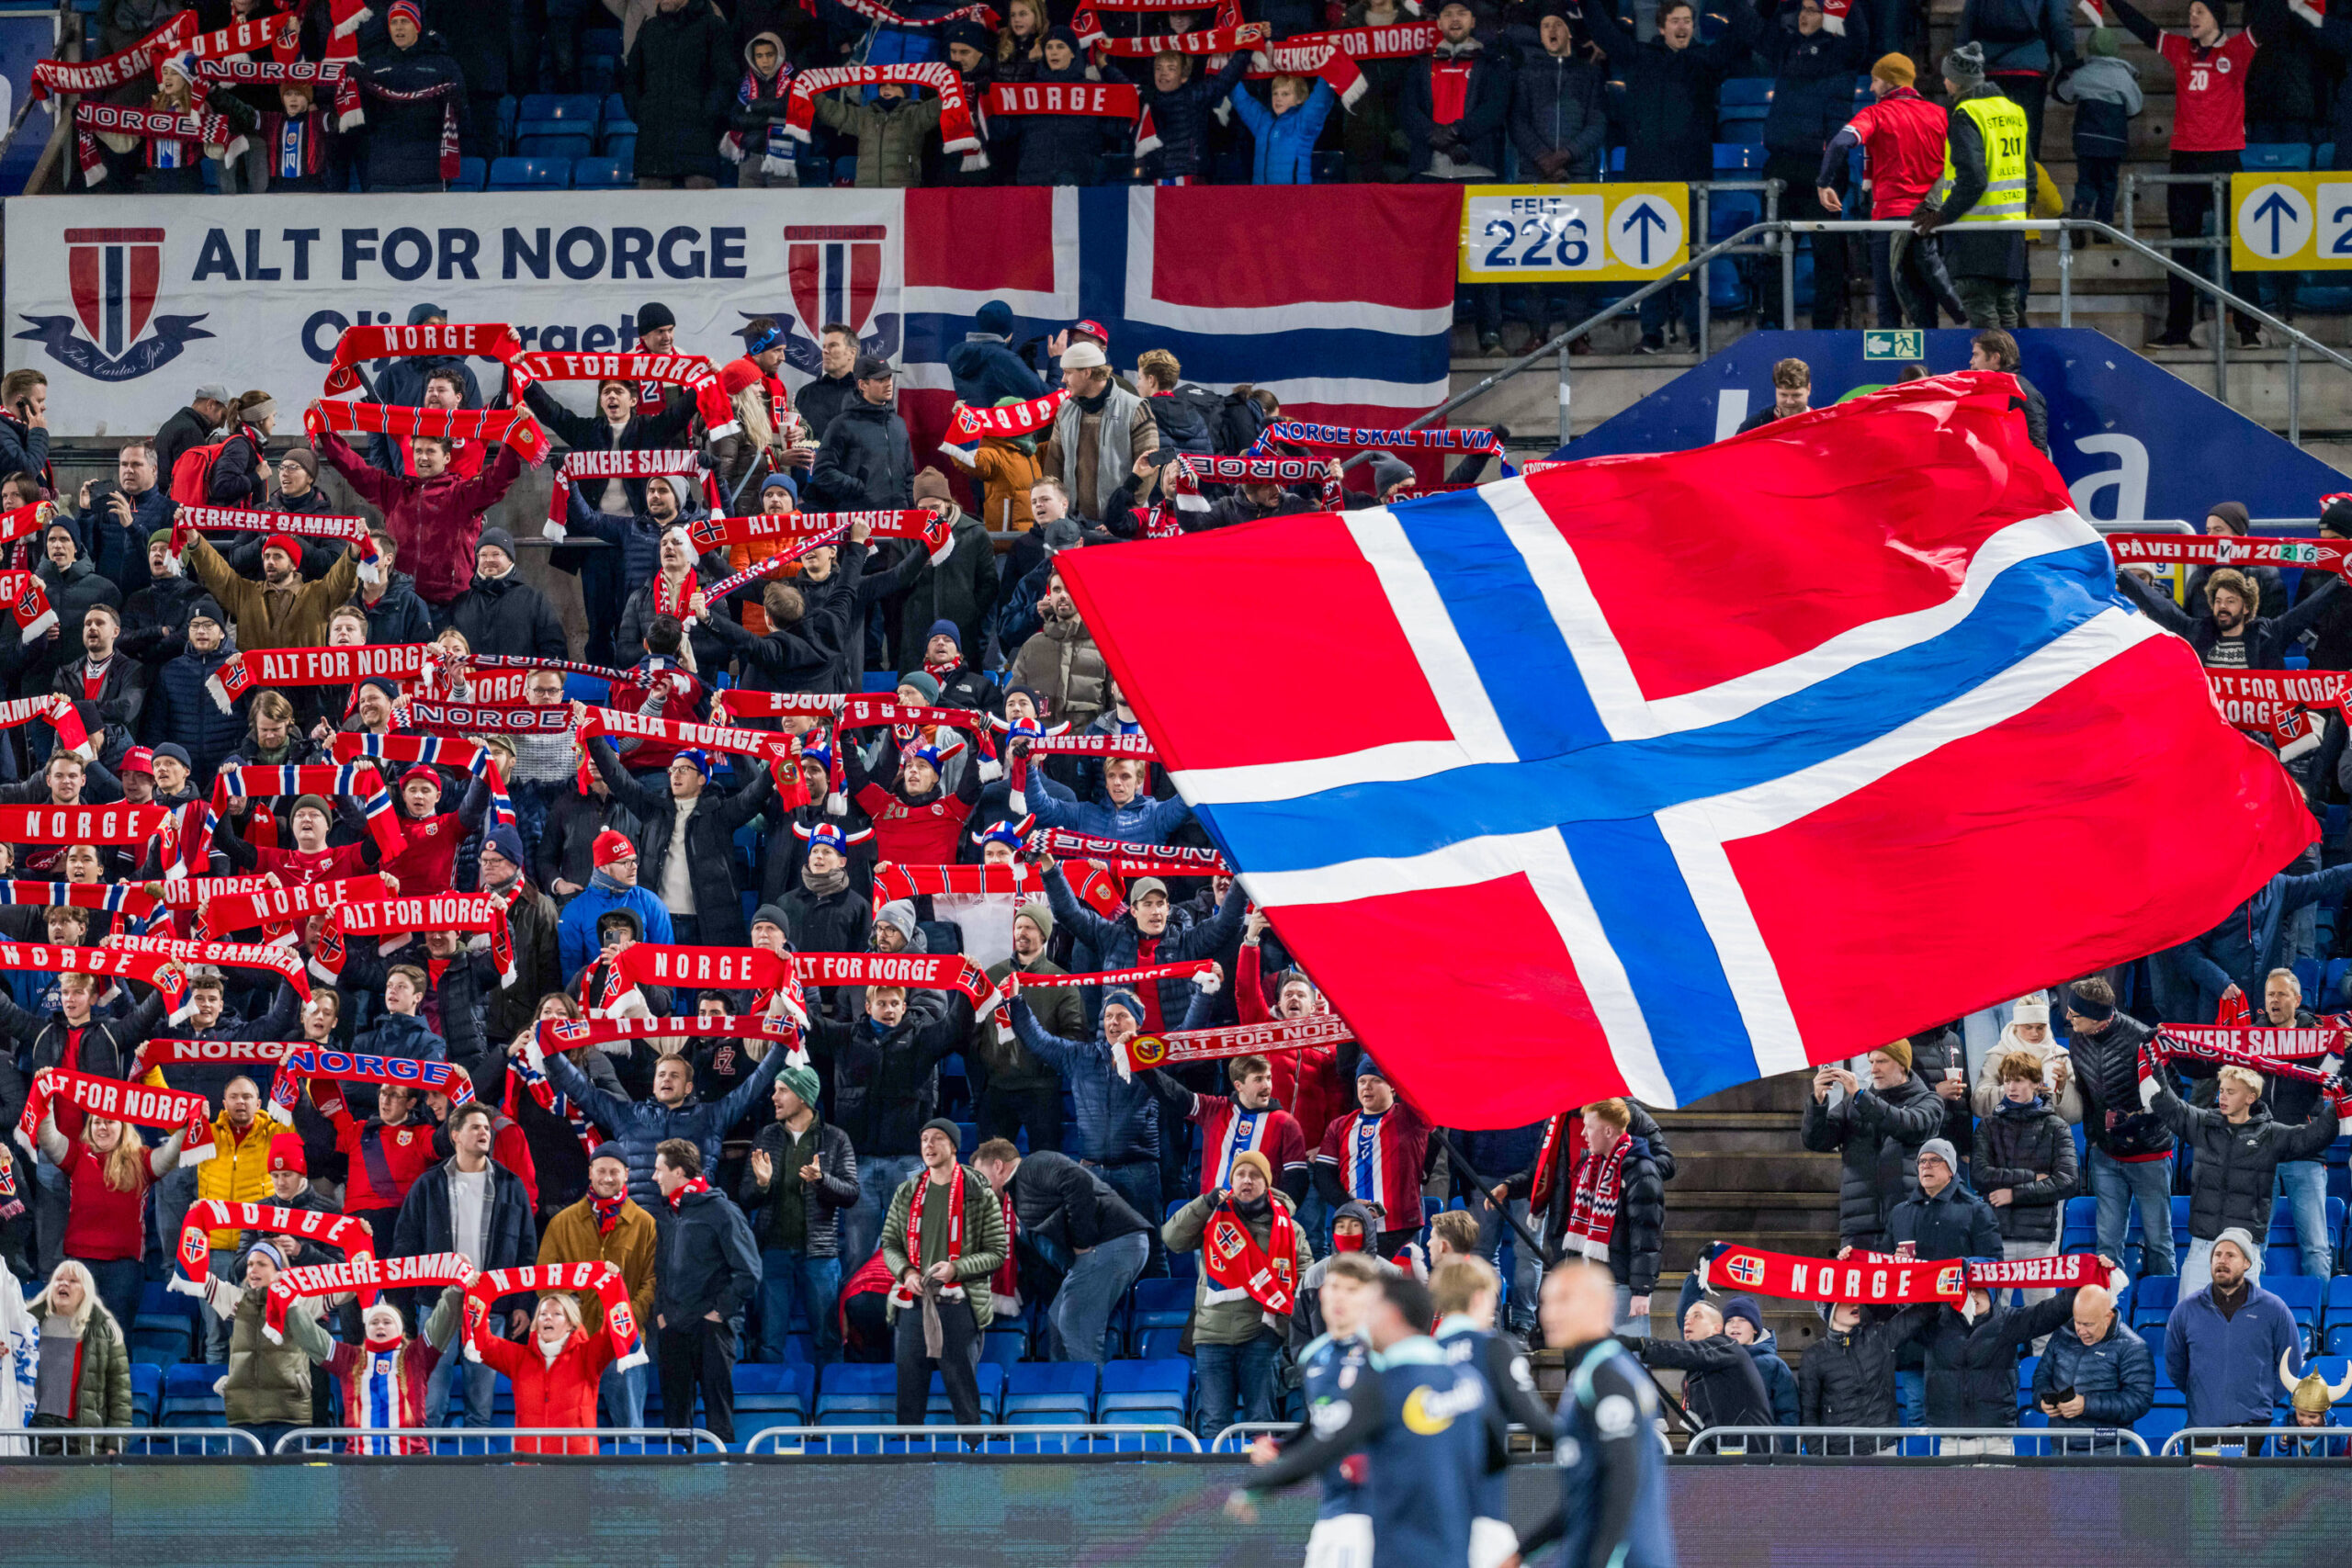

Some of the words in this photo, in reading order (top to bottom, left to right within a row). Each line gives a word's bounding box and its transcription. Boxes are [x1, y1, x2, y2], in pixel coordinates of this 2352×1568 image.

[1341, 37, 1368, 58] OR
[1373, 27, 1435, 55] NORGE
[201, 60, 346, 82] NORGE
[792, 65, 876, 100] SAMMEN
[2188, 69, 2209, 91] 20
[884, 62, 961, 110] STERKERE
[1000, 86, 1107, 111] NORGE
[1510, 197, 1562, 215] FELT
[191, 227, 321, 281] ALT
[341, 226, 481, 282] FOR
[502, 226, 748, 280] NORGE
[1484, 218, 1589, 267] 226
[384, 325, 476, 352] NORGE
[568, 354, 620, 377] FOR
[631, 355, 718, 390] NORGE
[1274, 422, 1351, 446] NORGE
[1355, 427, 1417, 447] SKAL
[1421, 430, 1456, 449] TIL
[1459, 428, 1492, 450] VM
[1193, 457, 1332, 480] NORGE
[182, 506, 271, 530] TERKERE
[2116, 539, 2145, 558] PÅ
[2146, 542, 2181, 558] VEI
[2187, 544, 2217, 558] TIL
[2256, 544, 2316, 561] 2026
[263, 653, 300, 679] ALT
[308, 649, 350, 677] FOR
[2242, 677, 2278, 700] FOR
[0, 695, 72, 722] AMMEN
[413, 702, 570, 729] NORGE
[599, 708, 667, 738] HEIA
[678, 719, 769, 753] NORGE
[26, 811, 140, 838] NORGE
[815, 835, 837, 845] NORGE
[165, 879, 191, 904] OR
[301, 869, 314, 886] 5
[251, 879, 347, 919] NORGE
[343, 904, 377, 930] ALT
[385, 900, 423, 926] FOR
[429, 897, 494, 925] NORGE
[2, 944, 135, 974] NORGE
[655, 952, 752, 980] NORGE
[795, 957, 816, 979] LT
[822, 957, 862, 979] FOR
[868, 957, 939, 982] NORGE
[1168, 1036, 1212, 1055] ALT
[1222, 1027, 1275, 1048] FOR
[1283, 1018, 1351, 1042] NORG
[288, 1050, 454, 1087] NORGE
[74, 1079, 119, 1112] FOR
[211, 1200, 354, 1241] NORGE
[270, 1260, 380, 1298] STERKERE
[387, 1252, 473, 1285] SAMME
[488, 1262, 617, 1292] NORGE
[1792, 1263, 1912, 1298] NORGE
[1972, 1255, 2081, 1282] STERKERE
